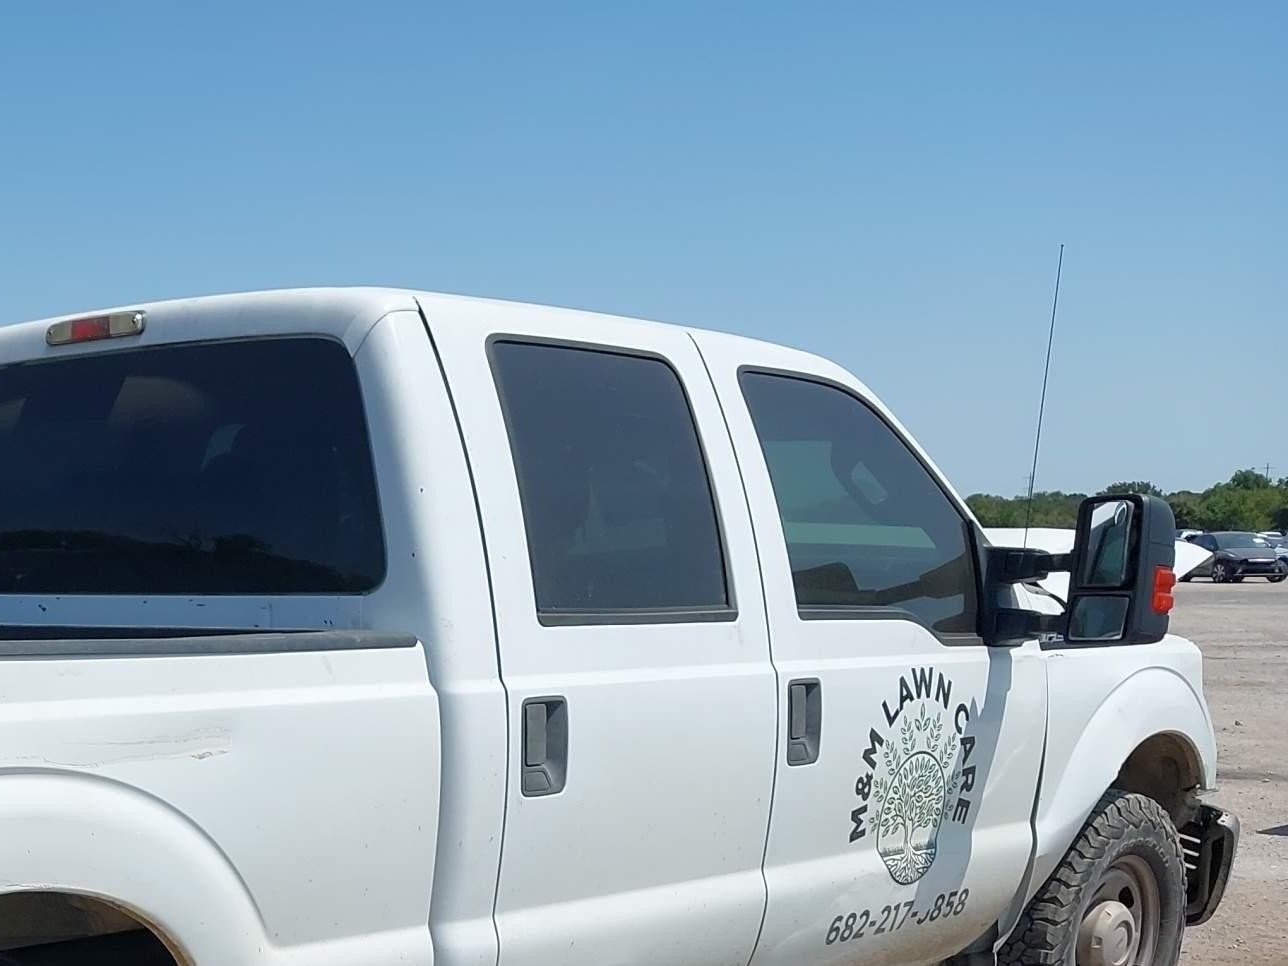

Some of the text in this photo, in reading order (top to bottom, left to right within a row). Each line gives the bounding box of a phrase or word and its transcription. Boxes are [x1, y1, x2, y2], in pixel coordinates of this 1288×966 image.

[849, 666, 976, 843] M&M LAWN CARE
